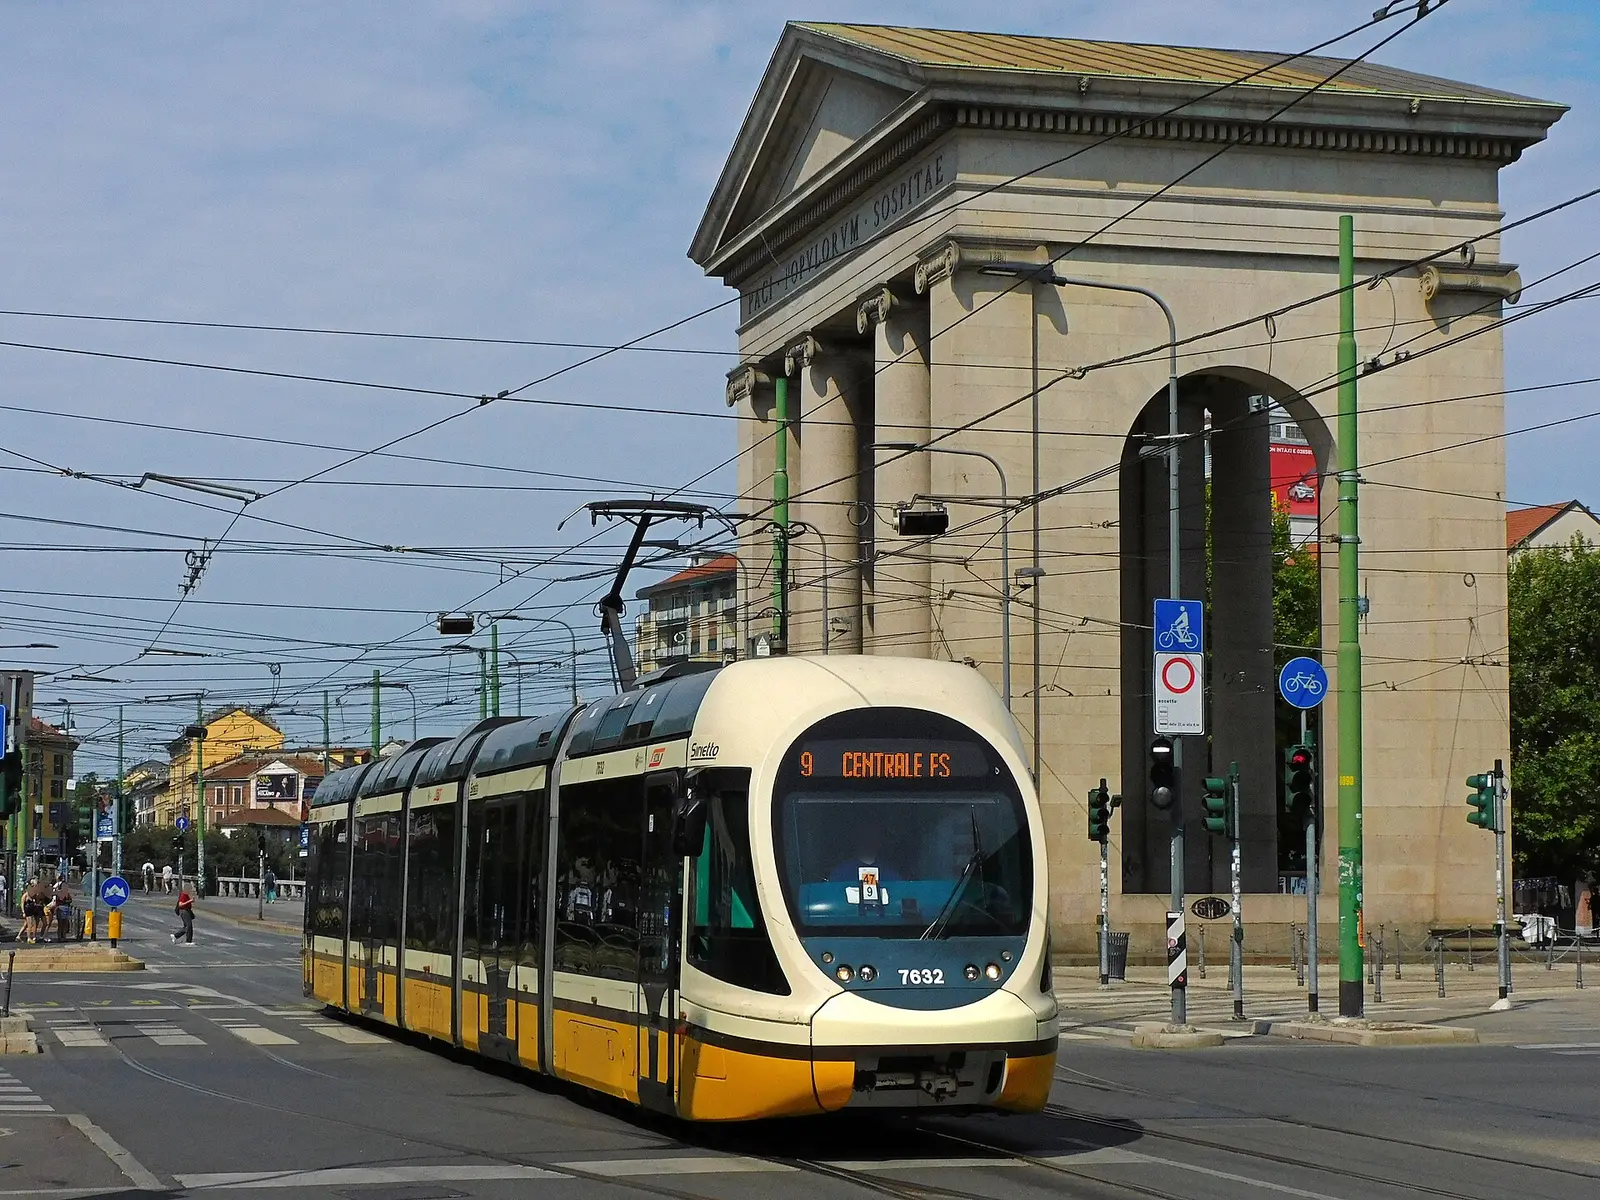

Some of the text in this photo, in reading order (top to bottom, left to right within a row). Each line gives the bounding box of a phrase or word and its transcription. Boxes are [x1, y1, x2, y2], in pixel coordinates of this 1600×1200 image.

[873, 154, 945, 228] SOSPITAE
[800, 751, 950, 777] 9 CENTRALE FS
[864, 873, 875, 885] 47
[866, 886, 873, 897] 9
[897, 968, 945, 985] 7632
